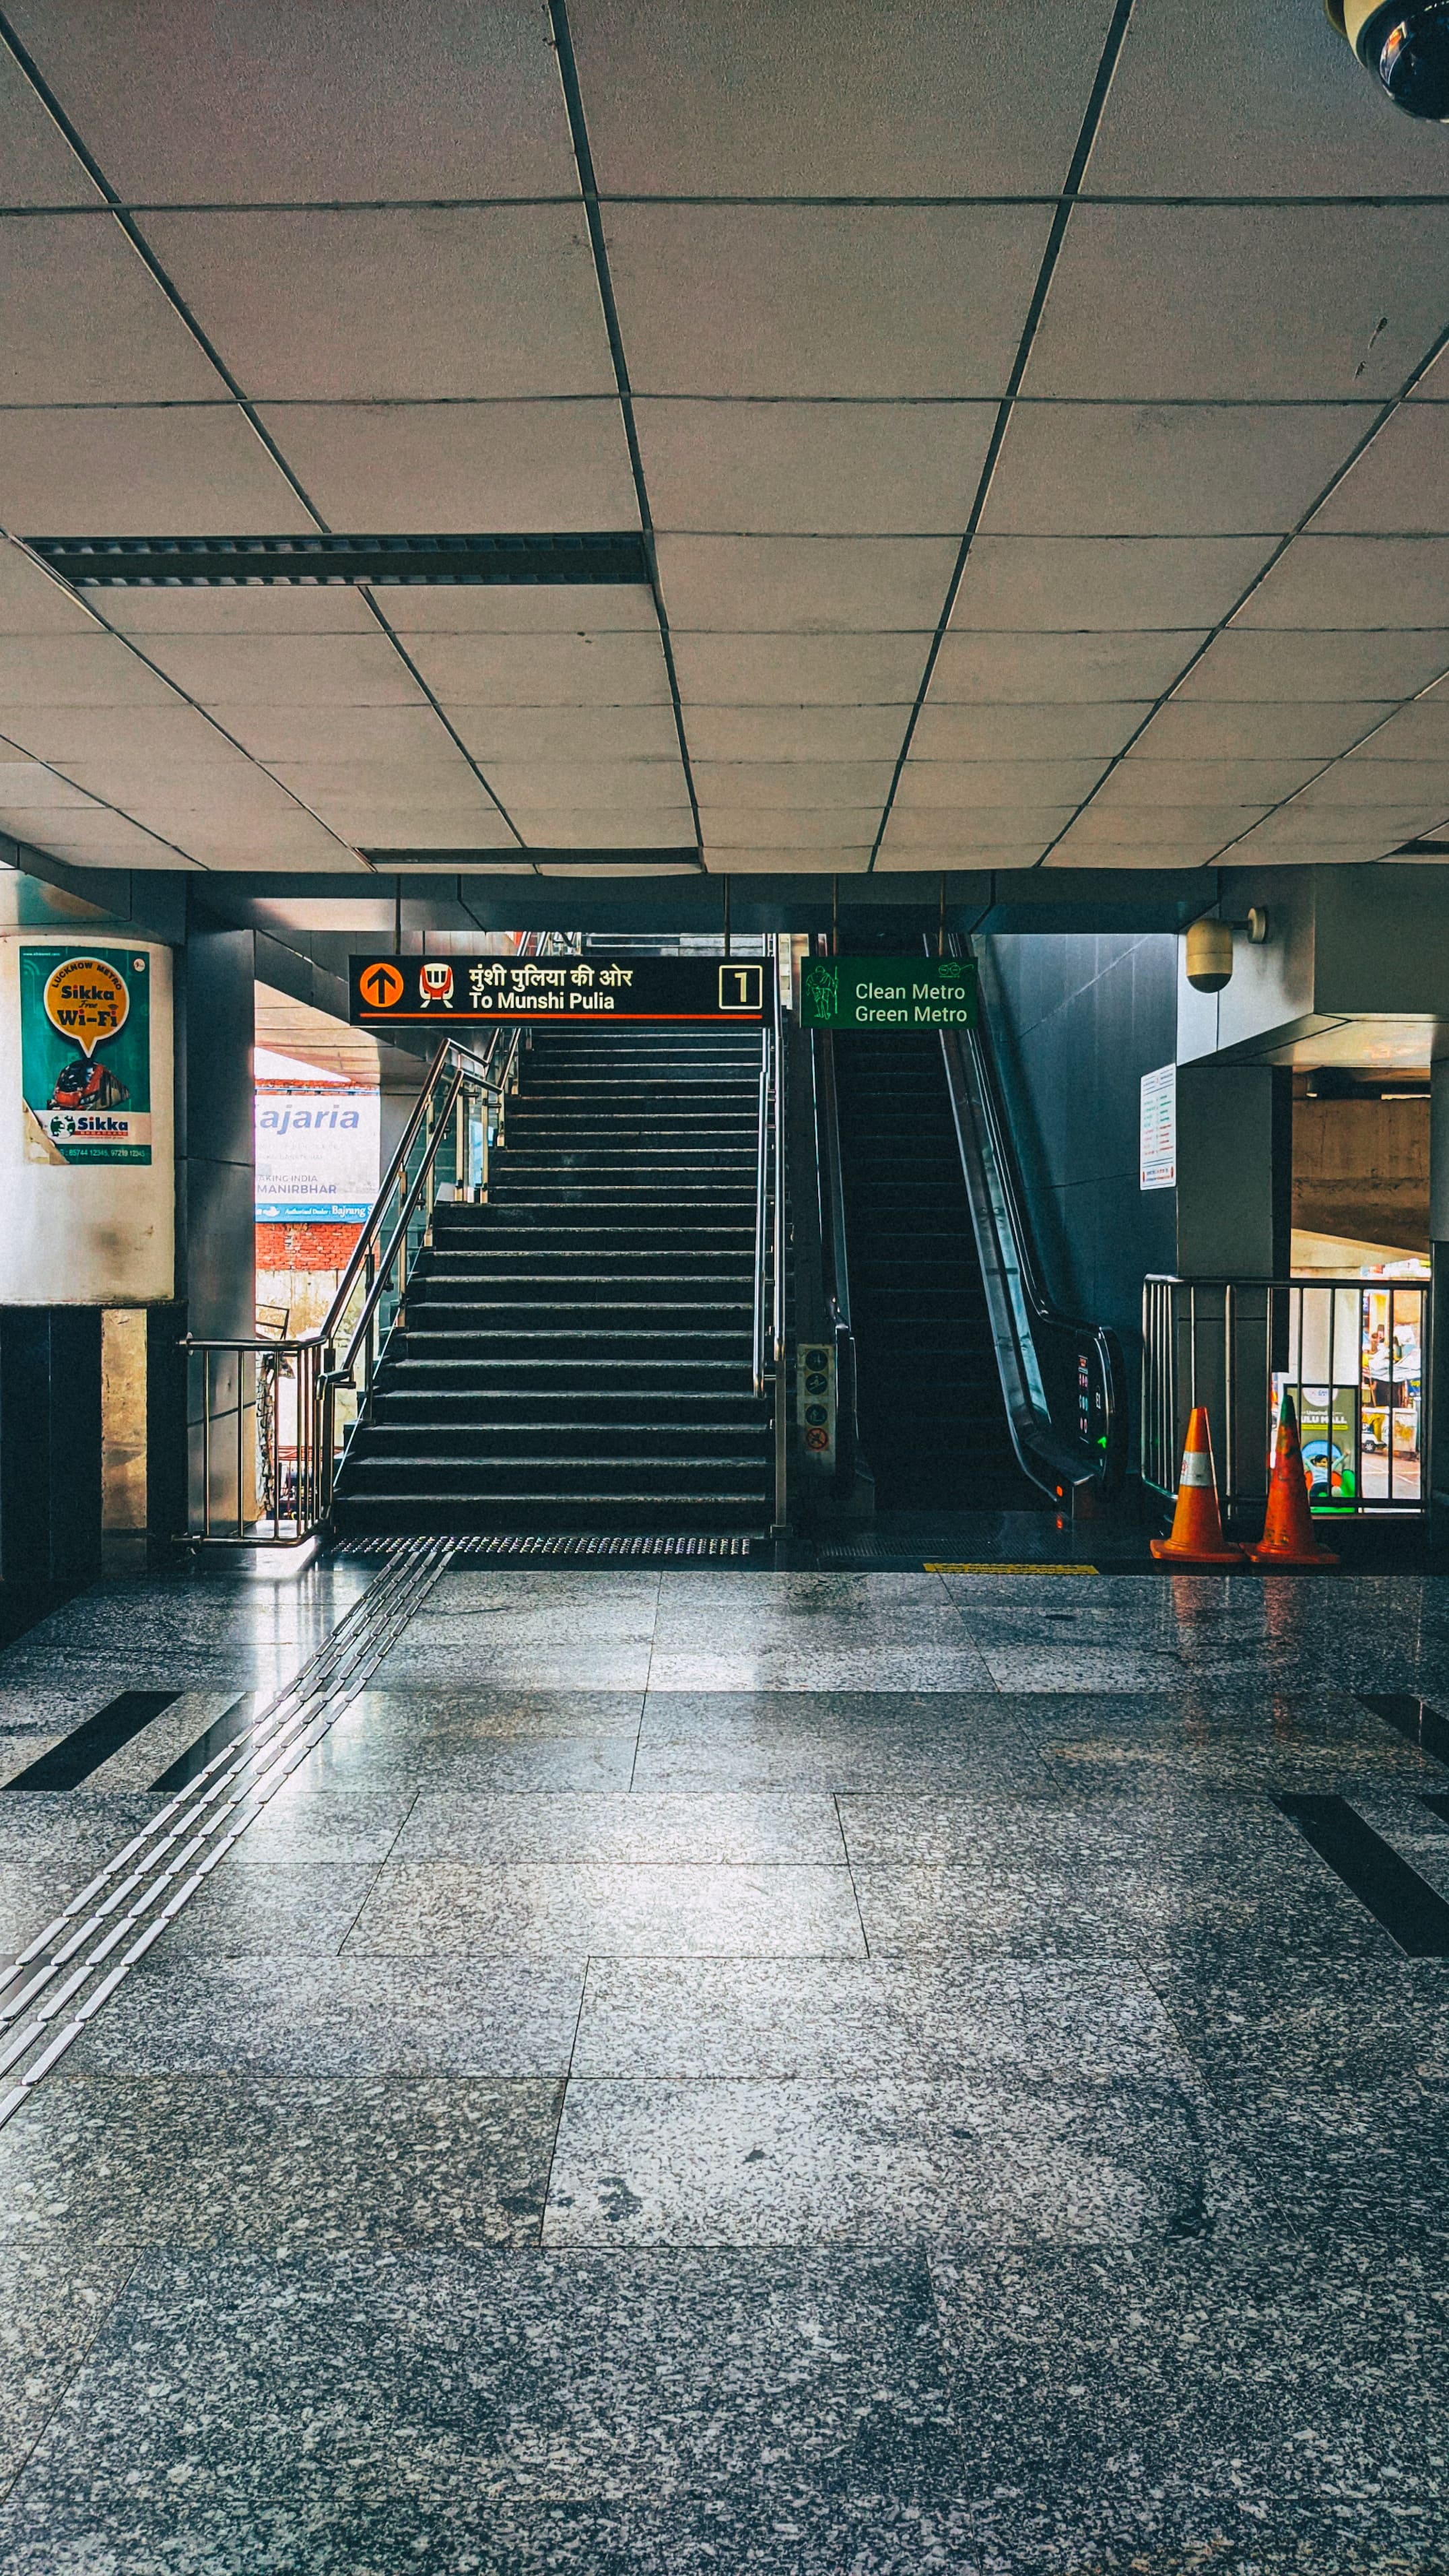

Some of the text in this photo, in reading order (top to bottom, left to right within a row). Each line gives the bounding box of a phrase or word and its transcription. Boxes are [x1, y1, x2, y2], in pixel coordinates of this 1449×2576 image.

[52, 962, 122, 990] LUCKNOW METRO
[469, 964, 633, 991] मुंशी पुलिया की ओर
[61, 985, 114, 1000] Sikka
[734, 972, 747, 1003] 1
[856, 983, 966, 1000] Clean Metro
[78, 1000, 98, 1008] Free
[469, 992, 615, 1009] To Munshi Pulia
[57, 1009, 118, 1027] Wi-Fi
[855, 1006, 968, 1022] Green Metro
[77, 1117, 128, 1131] Sikka
[257, 1104, 360, 1135] ajaria
[257, 1185, 337, 1194] MANIRBHAR
[332, 1205, 366, 1218] Bajrang
[1301, 1416, 1320, 1424] ULU
